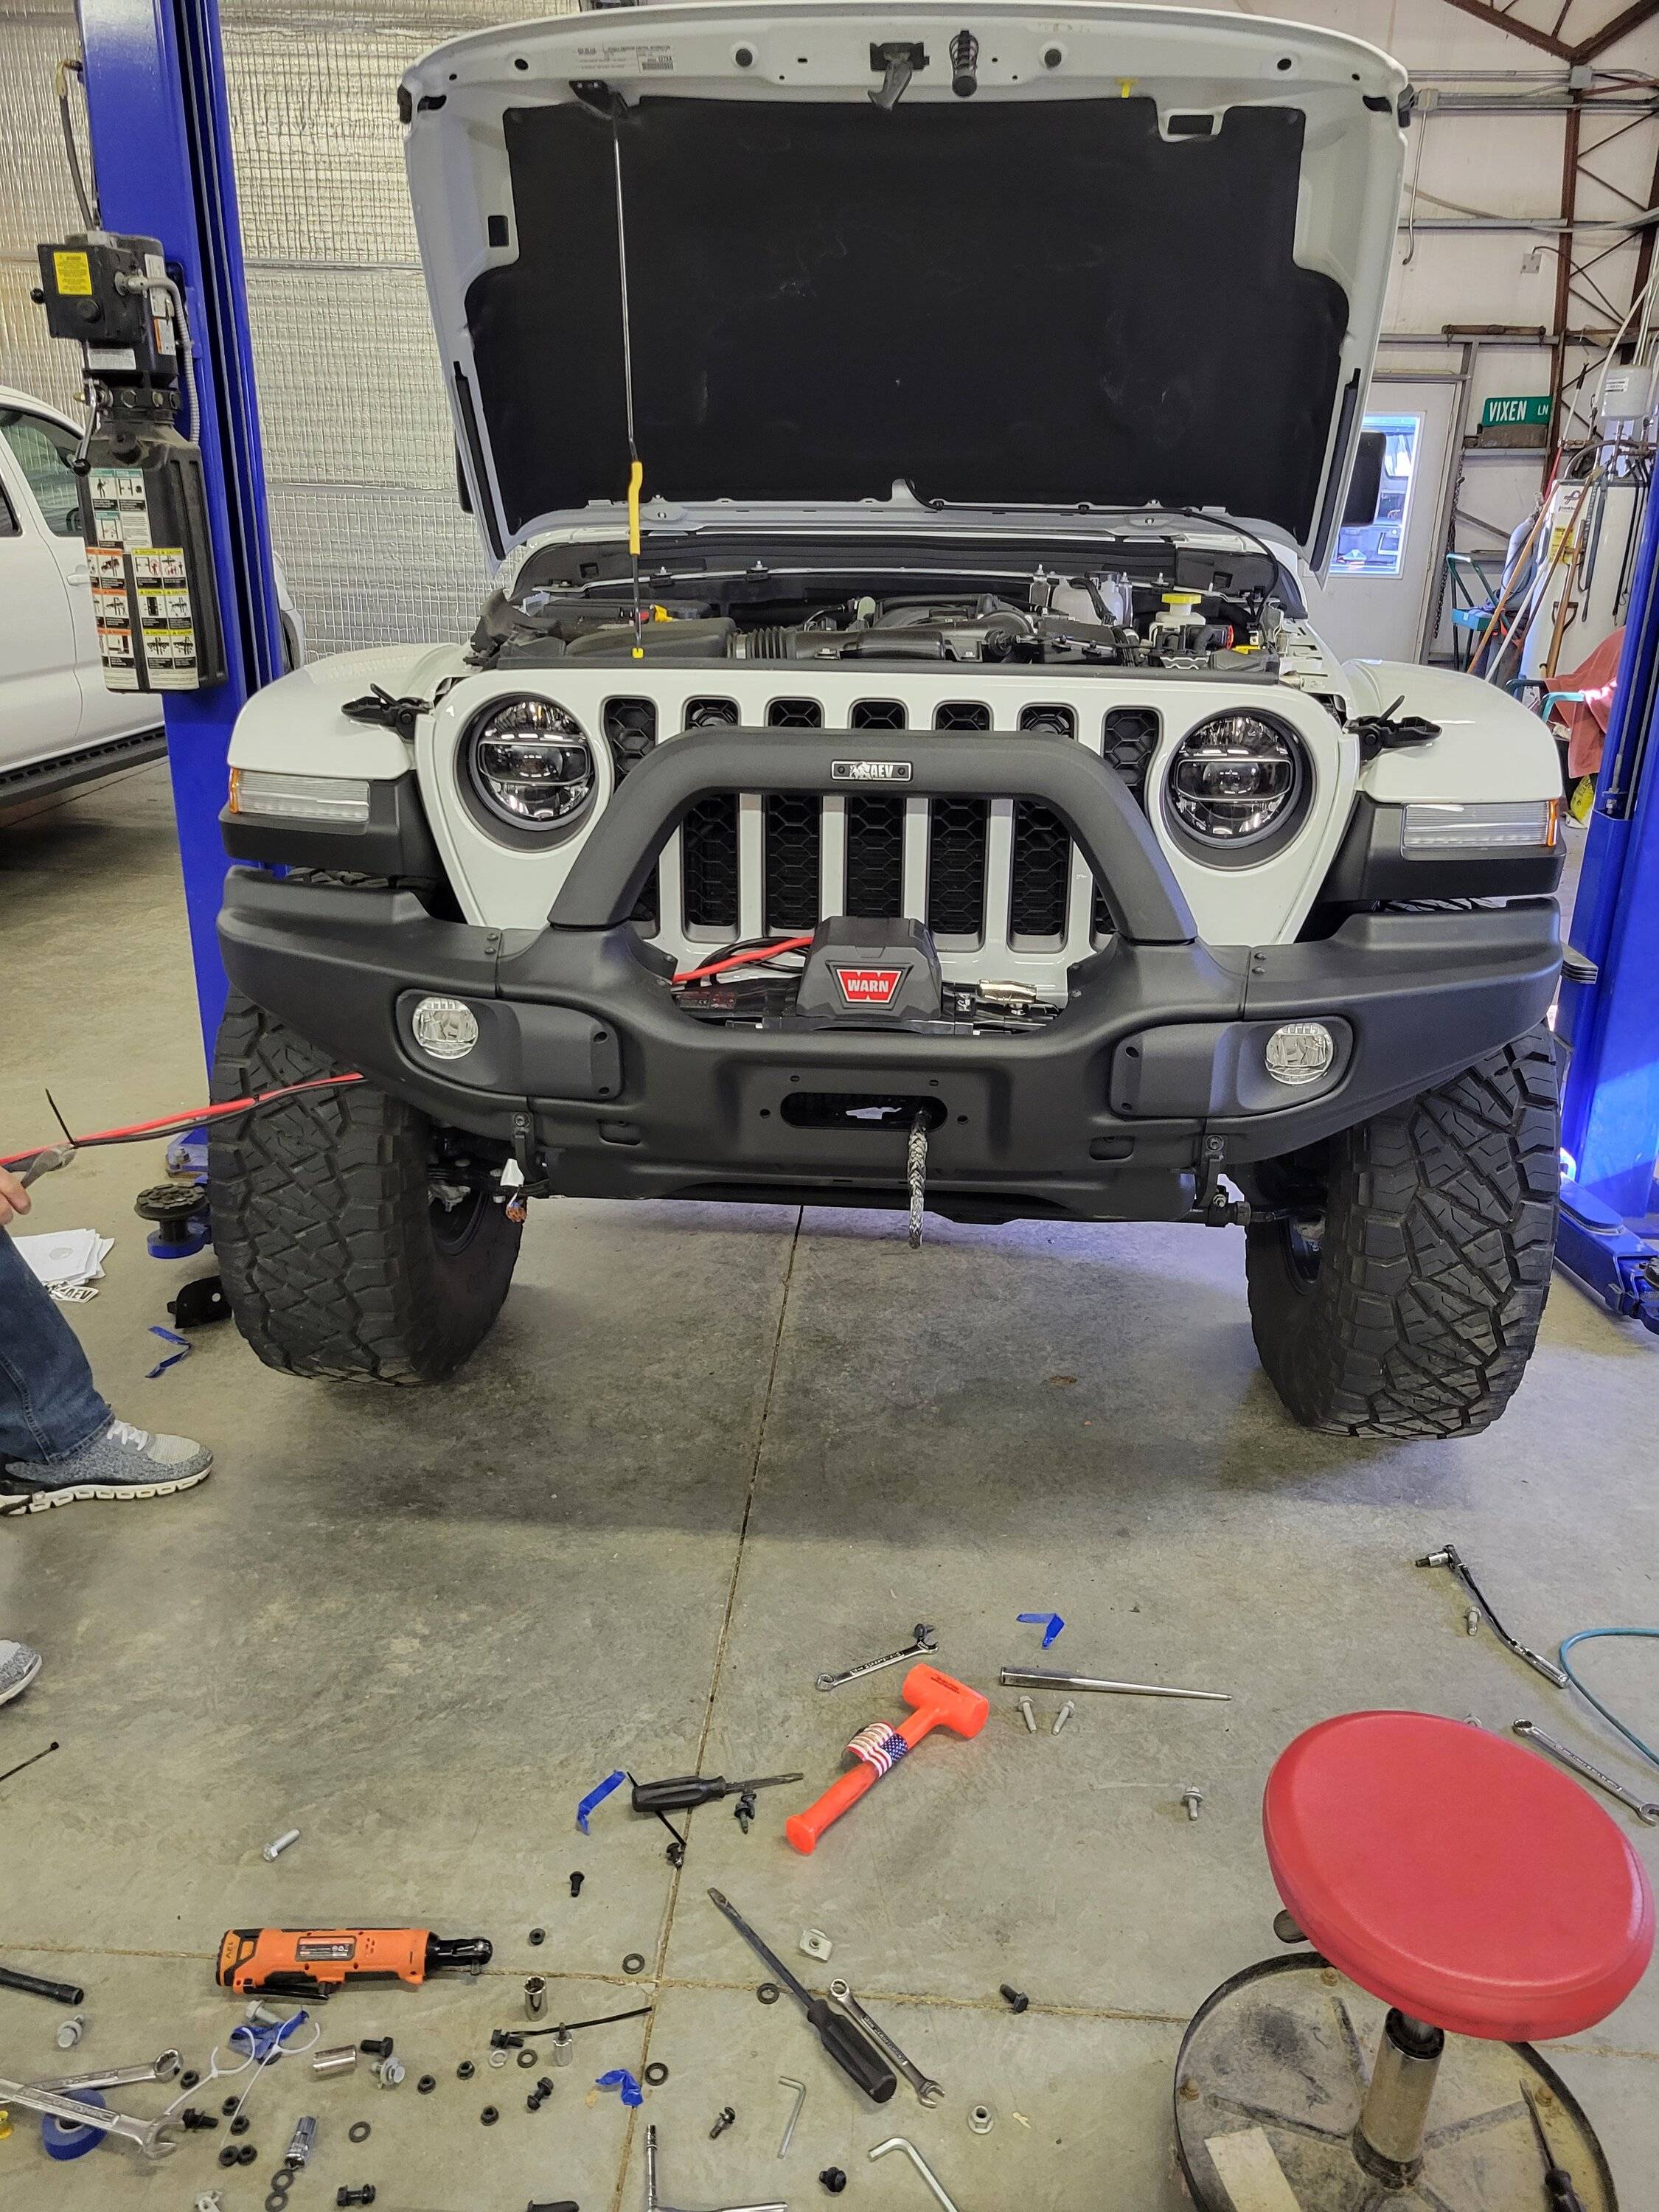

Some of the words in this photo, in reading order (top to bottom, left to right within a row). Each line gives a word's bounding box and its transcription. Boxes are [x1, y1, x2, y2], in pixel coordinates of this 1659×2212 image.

[1489, 400, 1527, 422] VIXEN
[1537, 404, 1549, 416] LN
[871, 765, 894, 778] AEV
[847, 979, 889, 992] WARN
[65, 1288, 93, 1300] AEV
